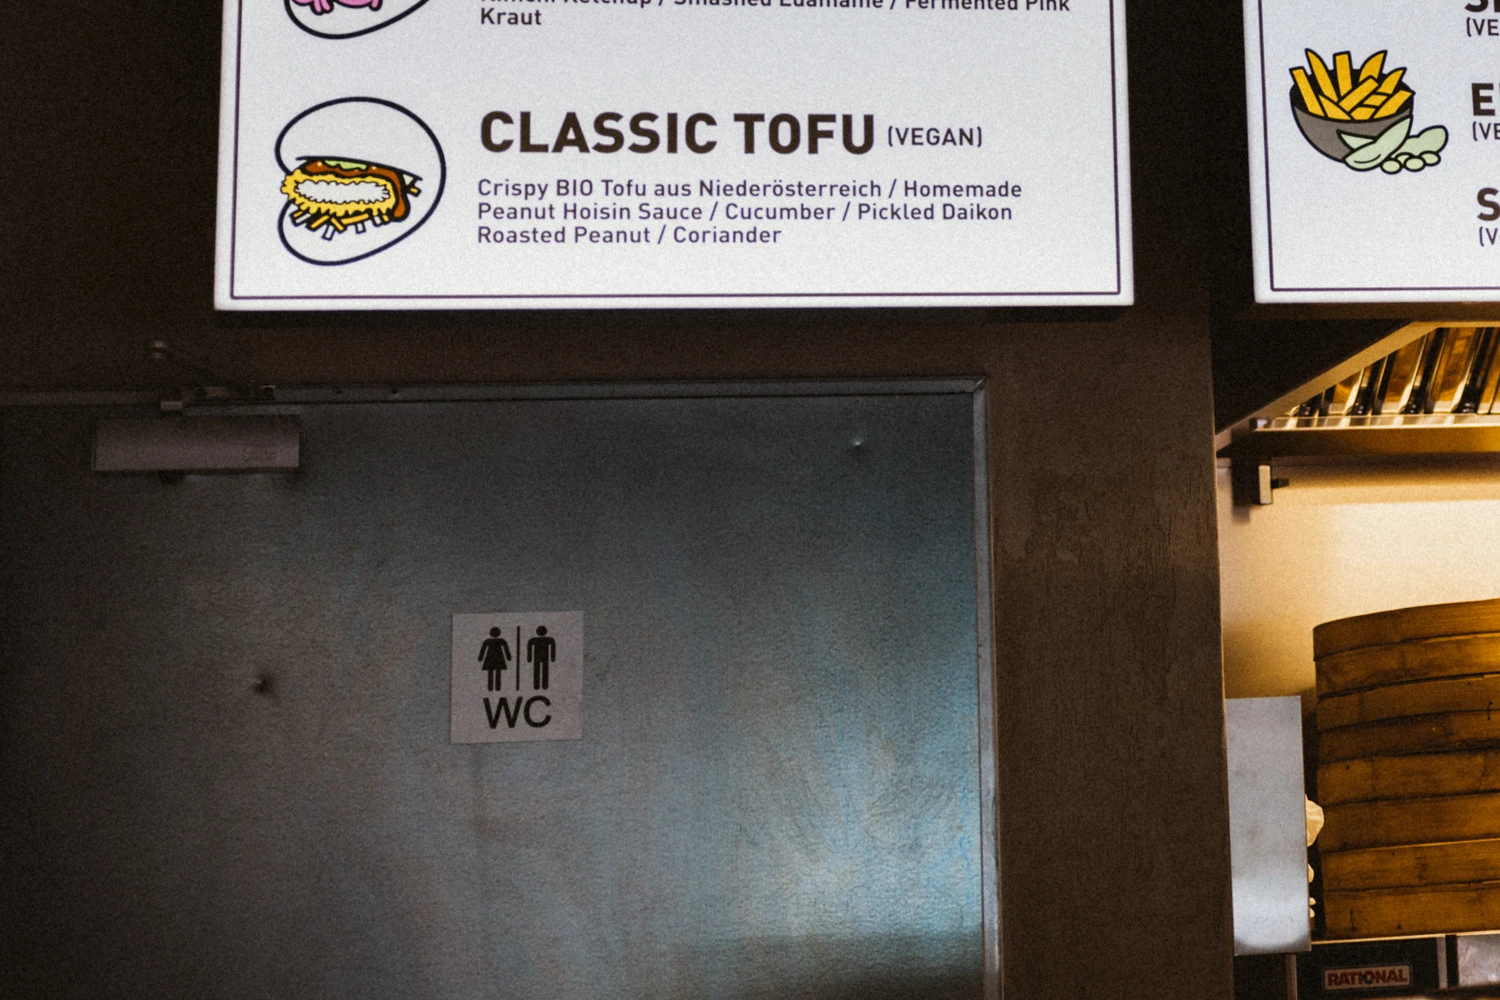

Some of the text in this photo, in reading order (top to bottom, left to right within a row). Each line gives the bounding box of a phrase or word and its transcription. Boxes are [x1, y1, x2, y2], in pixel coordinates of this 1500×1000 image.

[480, 6, 542, 26] Kraut
[480, 110, 983, 156] CLASSIC TOFU (VEGAN)
[477, 201, 1013, 221] Peanut Hoisin Sauce Cucumber Pickled Daikon
[477, 225, 783, 244] Roasted Peanut Coriander
[482, 694, 552, 730] WC
[1327, 968, 1408, 987] RATIONAL
